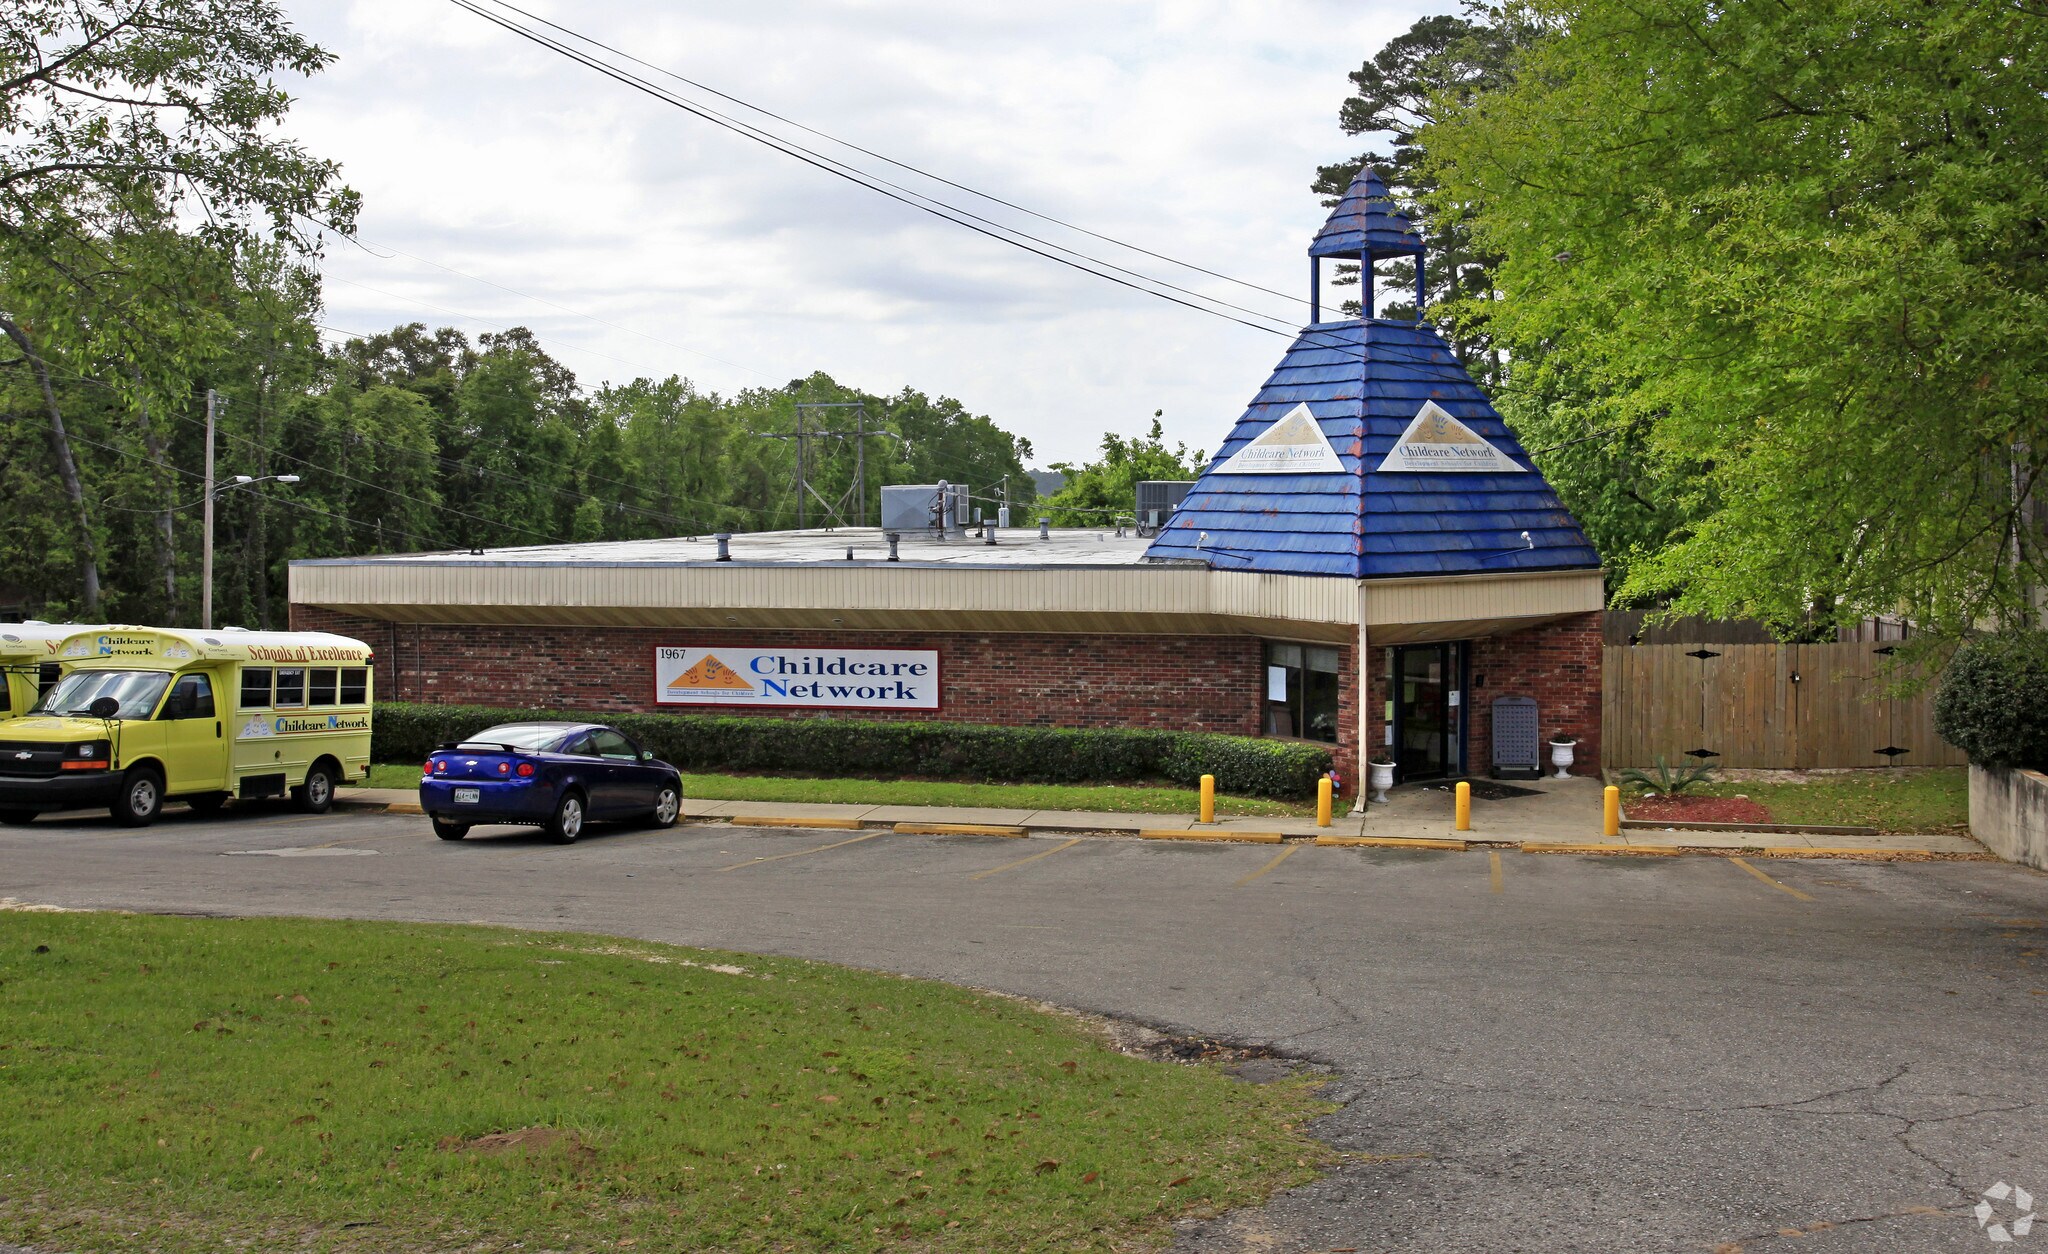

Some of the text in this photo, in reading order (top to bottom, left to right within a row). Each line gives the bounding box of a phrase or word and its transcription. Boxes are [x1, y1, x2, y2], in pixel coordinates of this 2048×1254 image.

[1241, 446, 1325, 459] Childcare Network
[1399, 445, 1495, 458] Childcare Network
[98, 635, 155, 645] Childcare
[99, 646, 154, 655] Network
[247, 644, 363, 661] Schools of Excellence
[660, 648, 686, 660] 1967
[749, 656, 928, 676] Childcare
[760, 679, 918, 700] Network
[275, 715, 368, 732] Childcare Network
